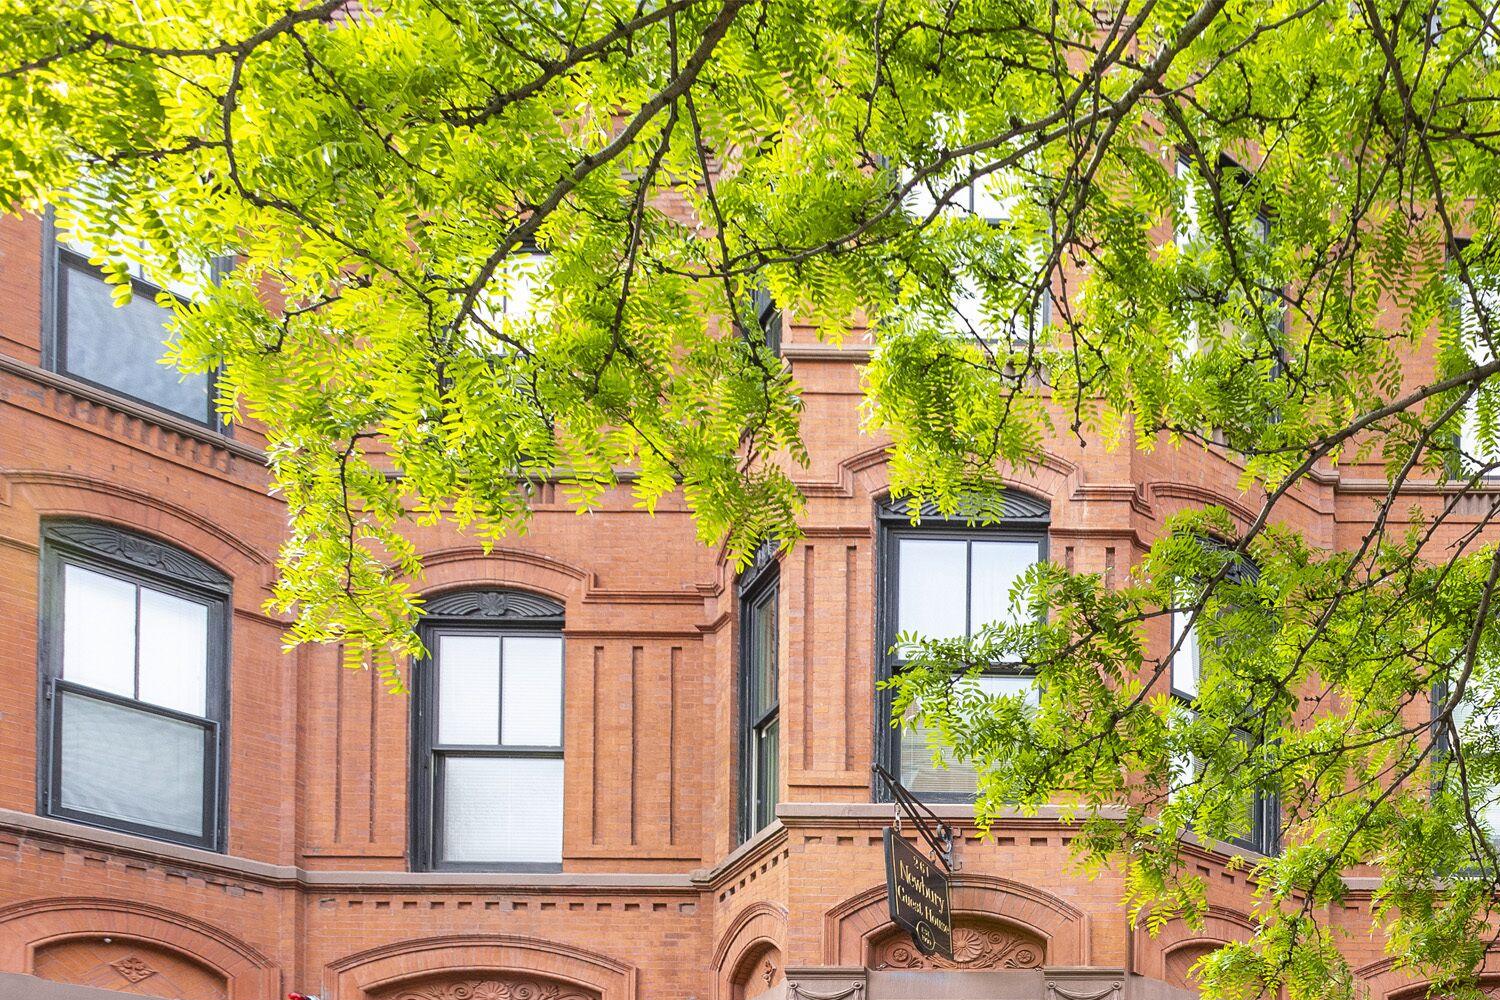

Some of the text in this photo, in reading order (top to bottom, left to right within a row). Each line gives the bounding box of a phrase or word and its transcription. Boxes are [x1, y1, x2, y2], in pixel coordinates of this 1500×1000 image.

[899, 859, 945, 915] Newbury
[912, 855, 930, 878] 261
[897, 885, 950, 935] Guest House
